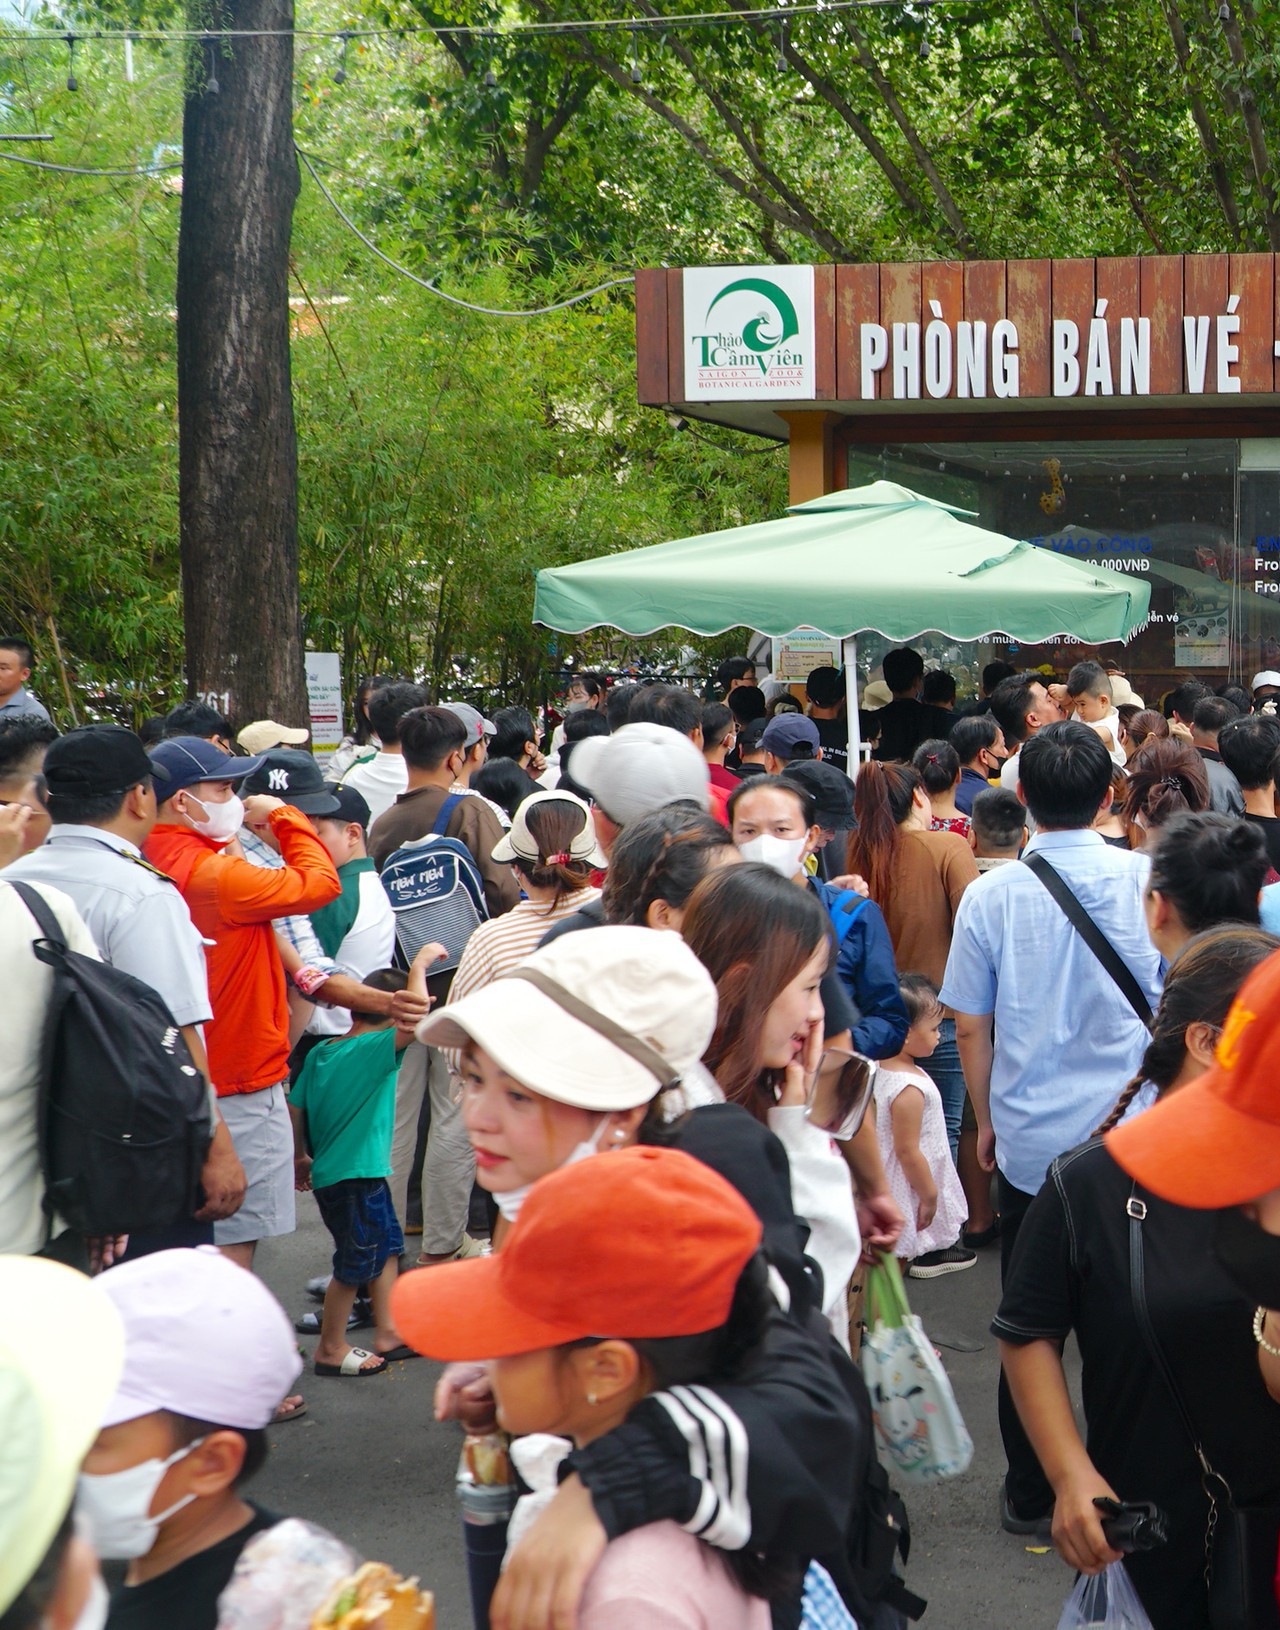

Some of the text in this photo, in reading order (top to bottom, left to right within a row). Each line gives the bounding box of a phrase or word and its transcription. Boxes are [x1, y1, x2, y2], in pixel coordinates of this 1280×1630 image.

[860, 299, 1019, 400] PHÒNG
[1053, 298, 1151, 397] BÁN
[1183, 295, 1241, 394] VÉ
[1166, 612, 1179, 622] vé
